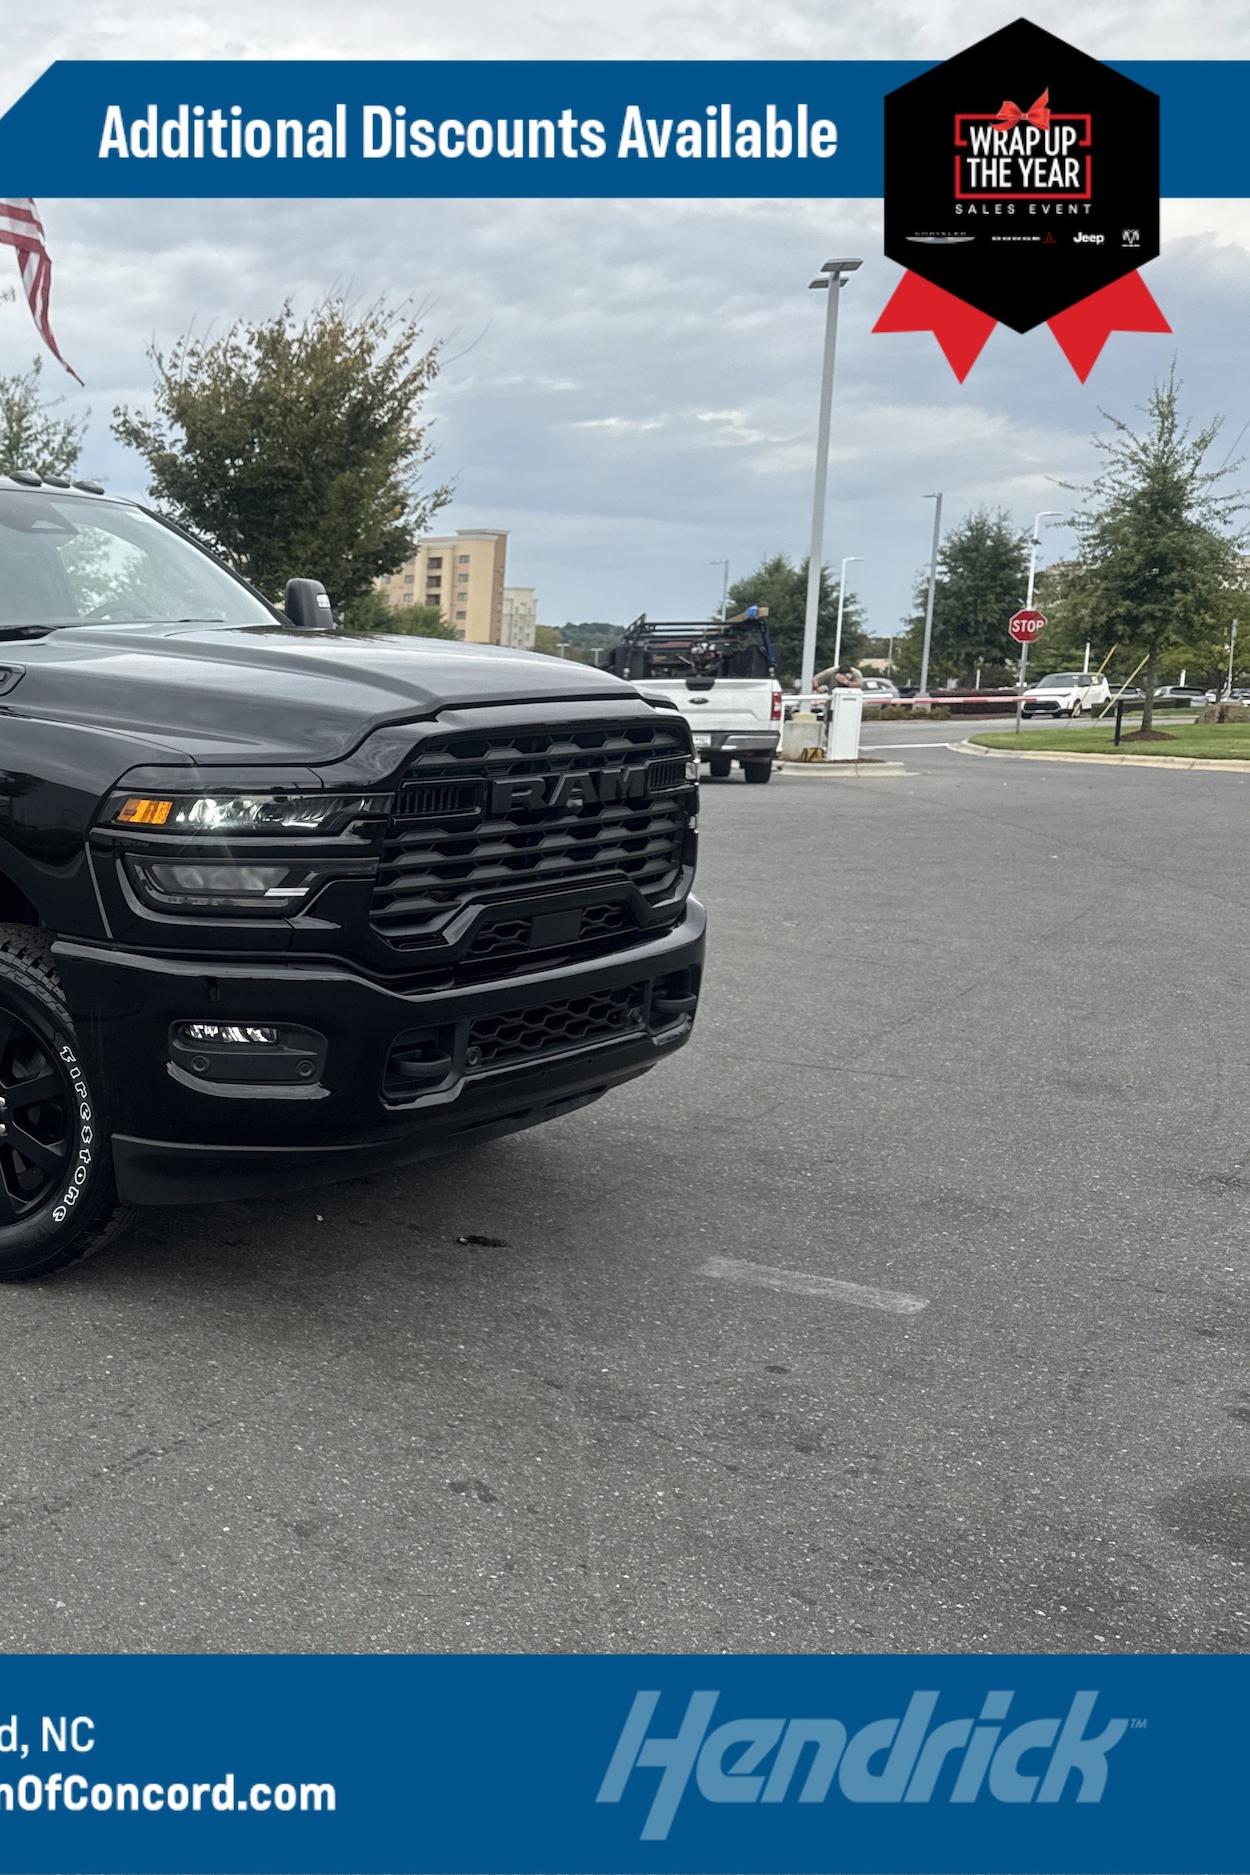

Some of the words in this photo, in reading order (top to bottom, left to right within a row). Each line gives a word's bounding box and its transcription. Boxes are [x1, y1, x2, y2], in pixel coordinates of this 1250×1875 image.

[1011, 619, 1045, 633] STOP
[491, 765, 649, 815] RAM
[52, 1045, 94, 1222] Firestone
